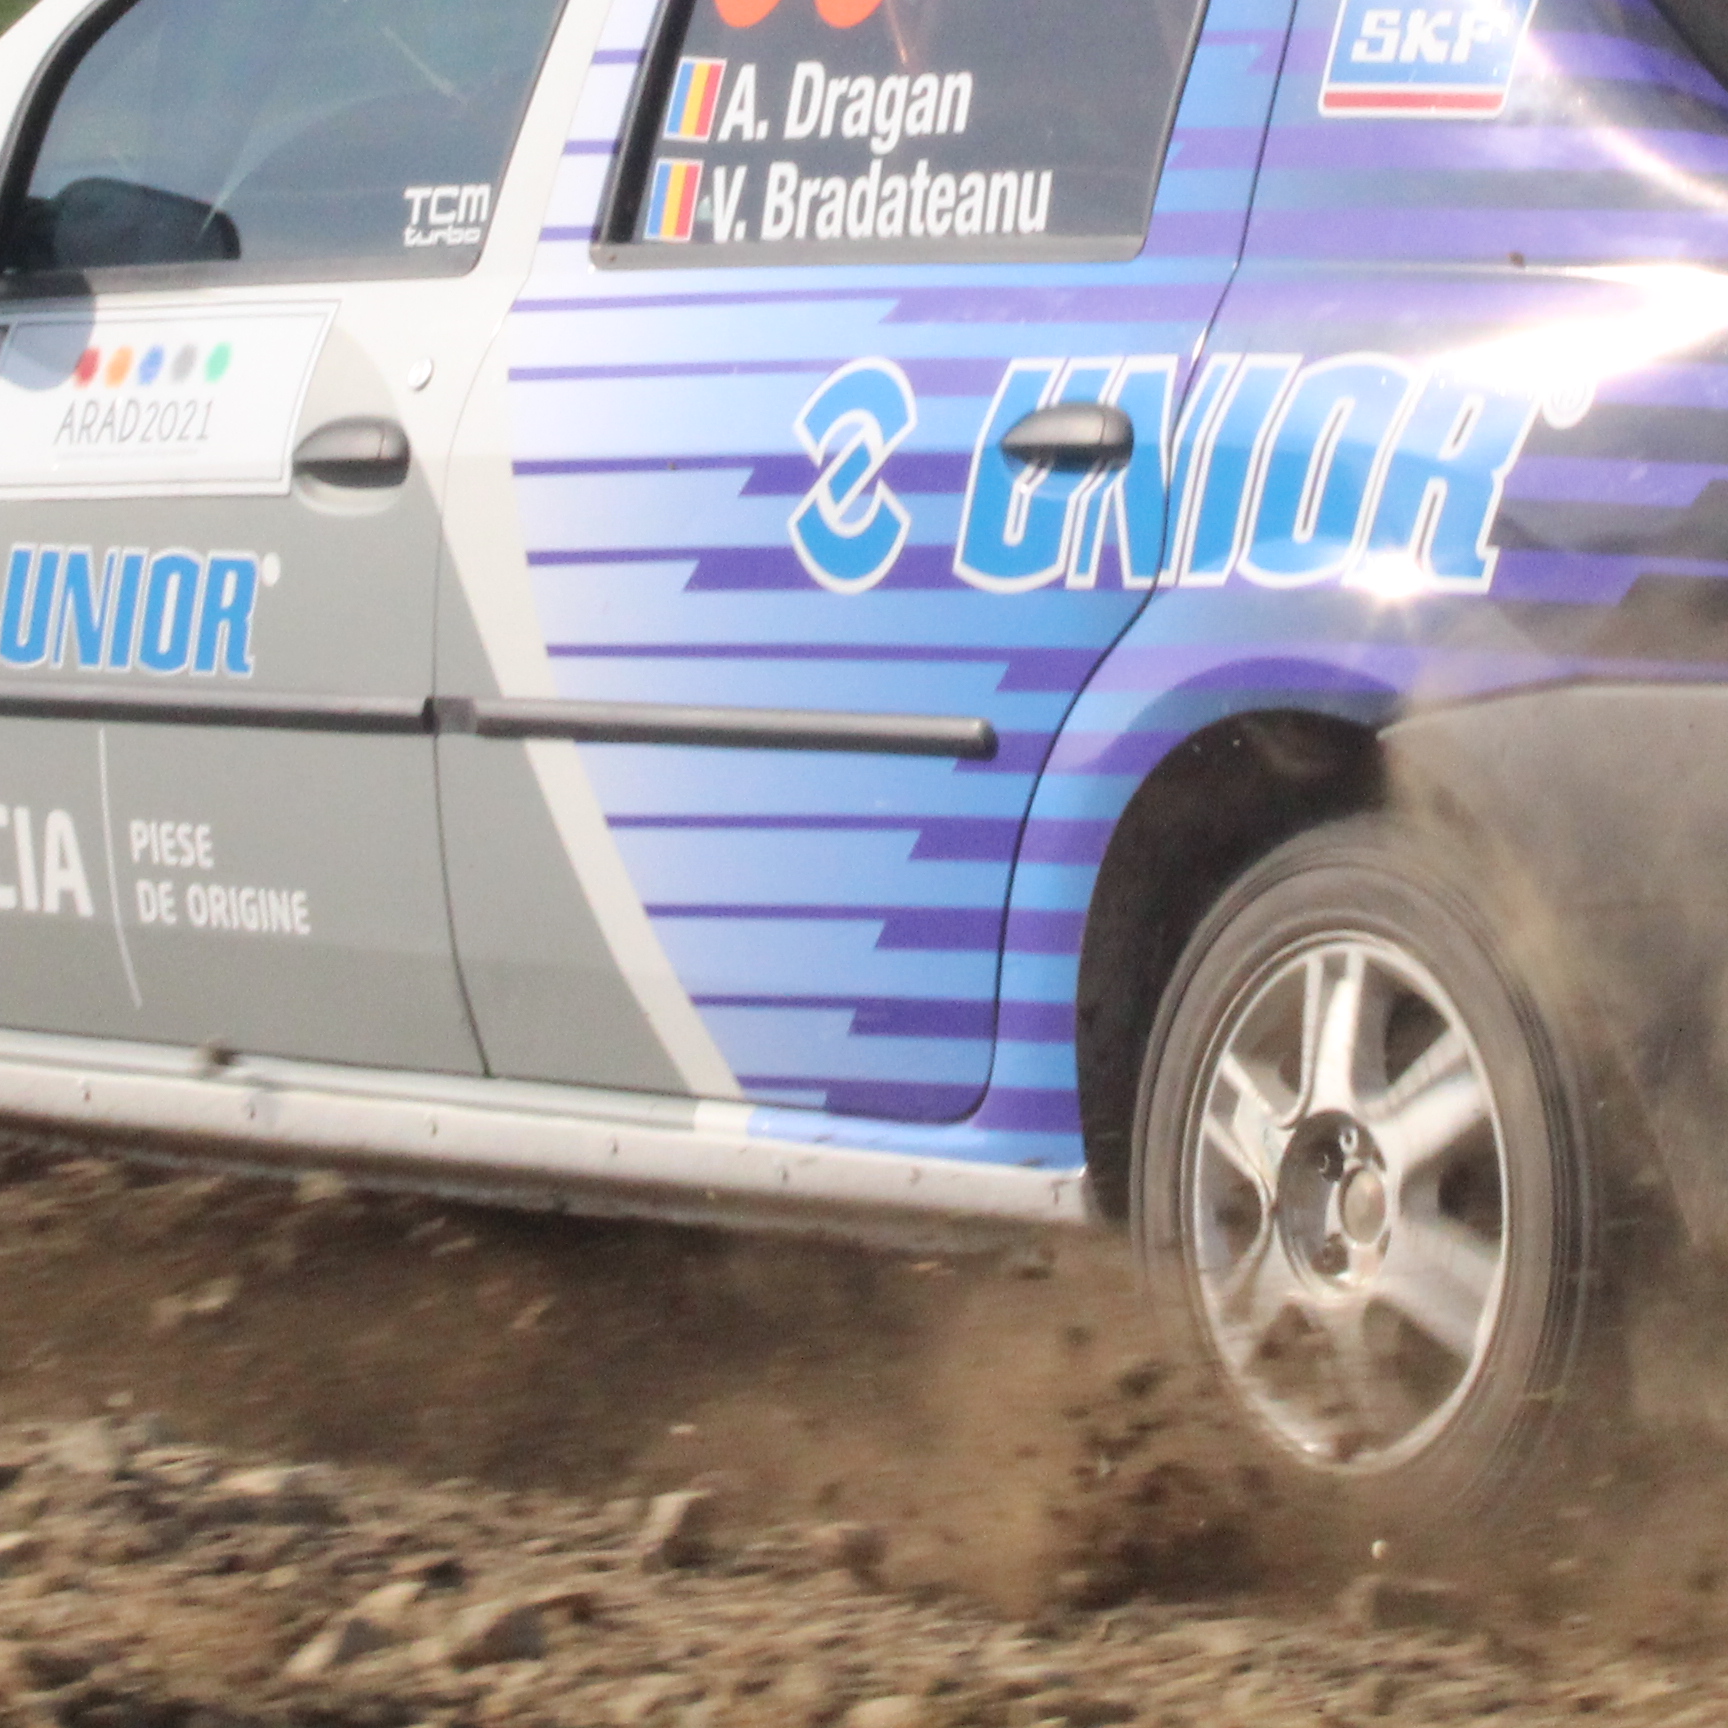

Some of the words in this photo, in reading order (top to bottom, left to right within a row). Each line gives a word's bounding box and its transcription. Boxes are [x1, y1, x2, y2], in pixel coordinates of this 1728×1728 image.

[1350, 8, 1512, 64] SKF
[718, 65, 767, 142] A.
[784, 62, 974, 154] Dragan
[403, 183, 492, 225] TCM
[709, 165, 747, 243] V.
[761, 159, 1054, 241] Bradateanu
[952, 352, 1542, 594] UNIOR
[129, 819, 215, 870] PIESE
[136, 879, 177, 926] DE
[186, 882, 312, 936] ORIGINE
